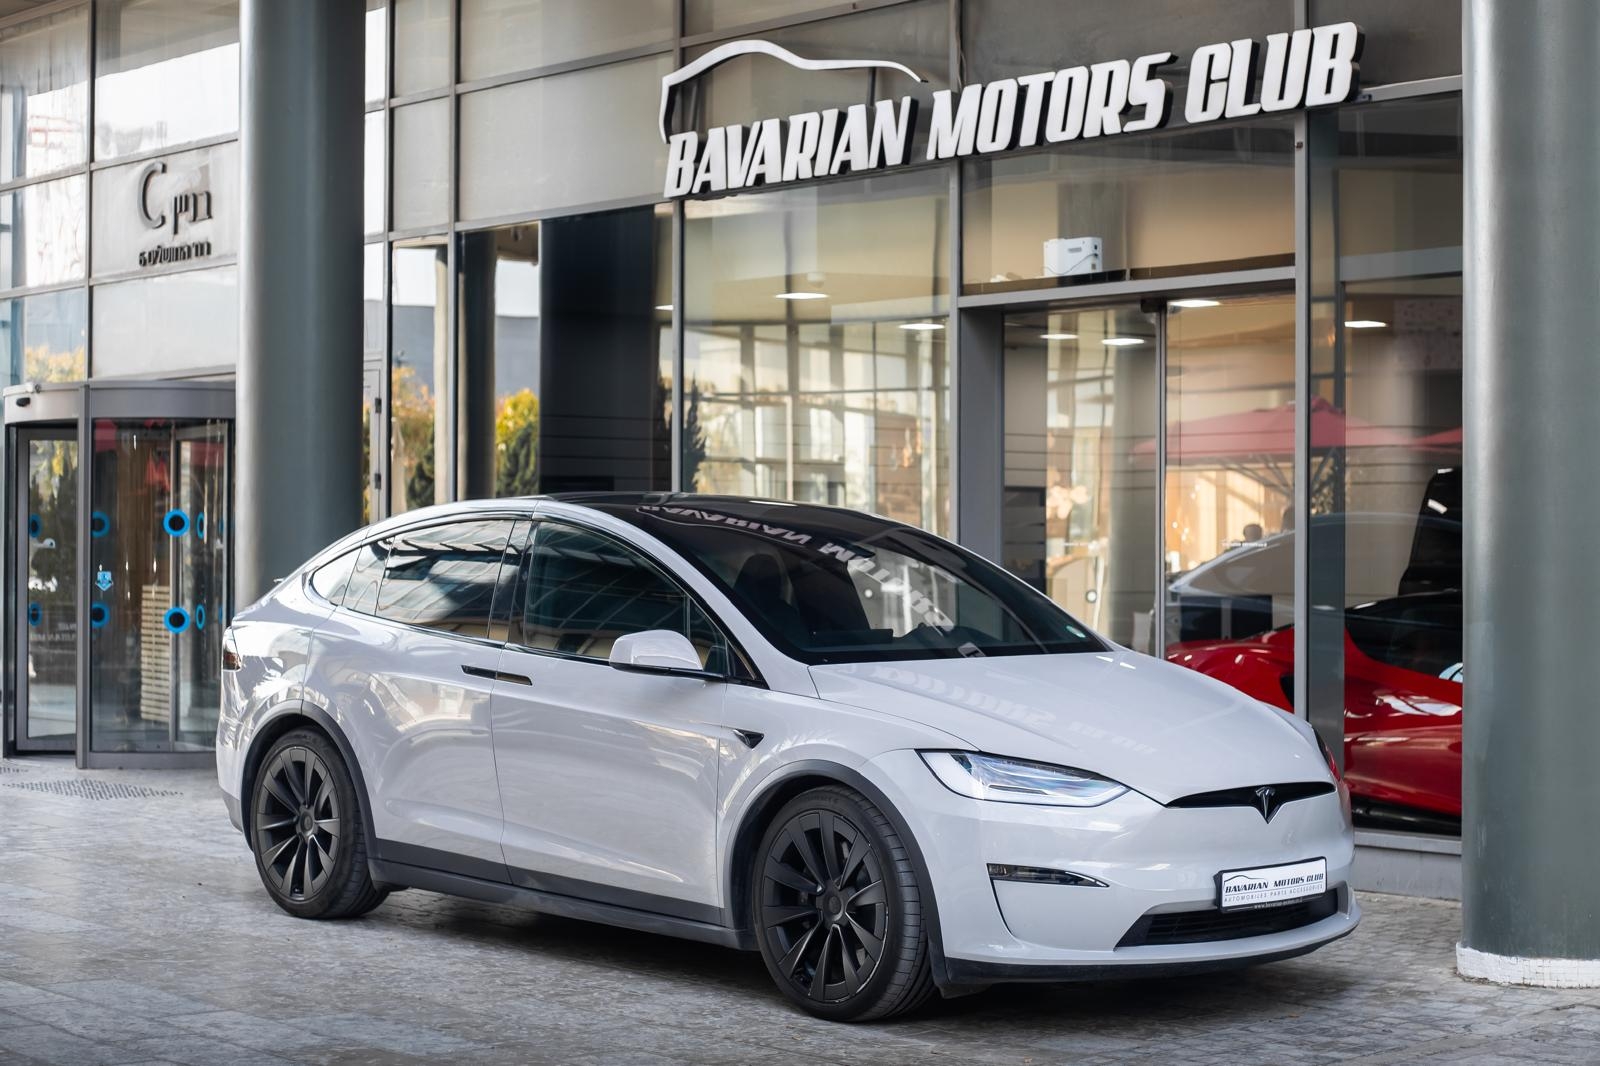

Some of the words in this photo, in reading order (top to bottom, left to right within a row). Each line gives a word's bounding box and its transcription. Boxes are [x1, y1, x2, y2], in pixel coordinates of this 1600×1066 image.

[663, 95, 913, 198] BAVARIAN
[926, 51, 1174, 160] MOTORS
[1184, 21, 1359, 125] CLUB
[1225, 882, 1269, 893] BAVARIAN
[1273, 877, 1305, 888] MOTORS
[1306, 873, 1324, 882] CLUB
